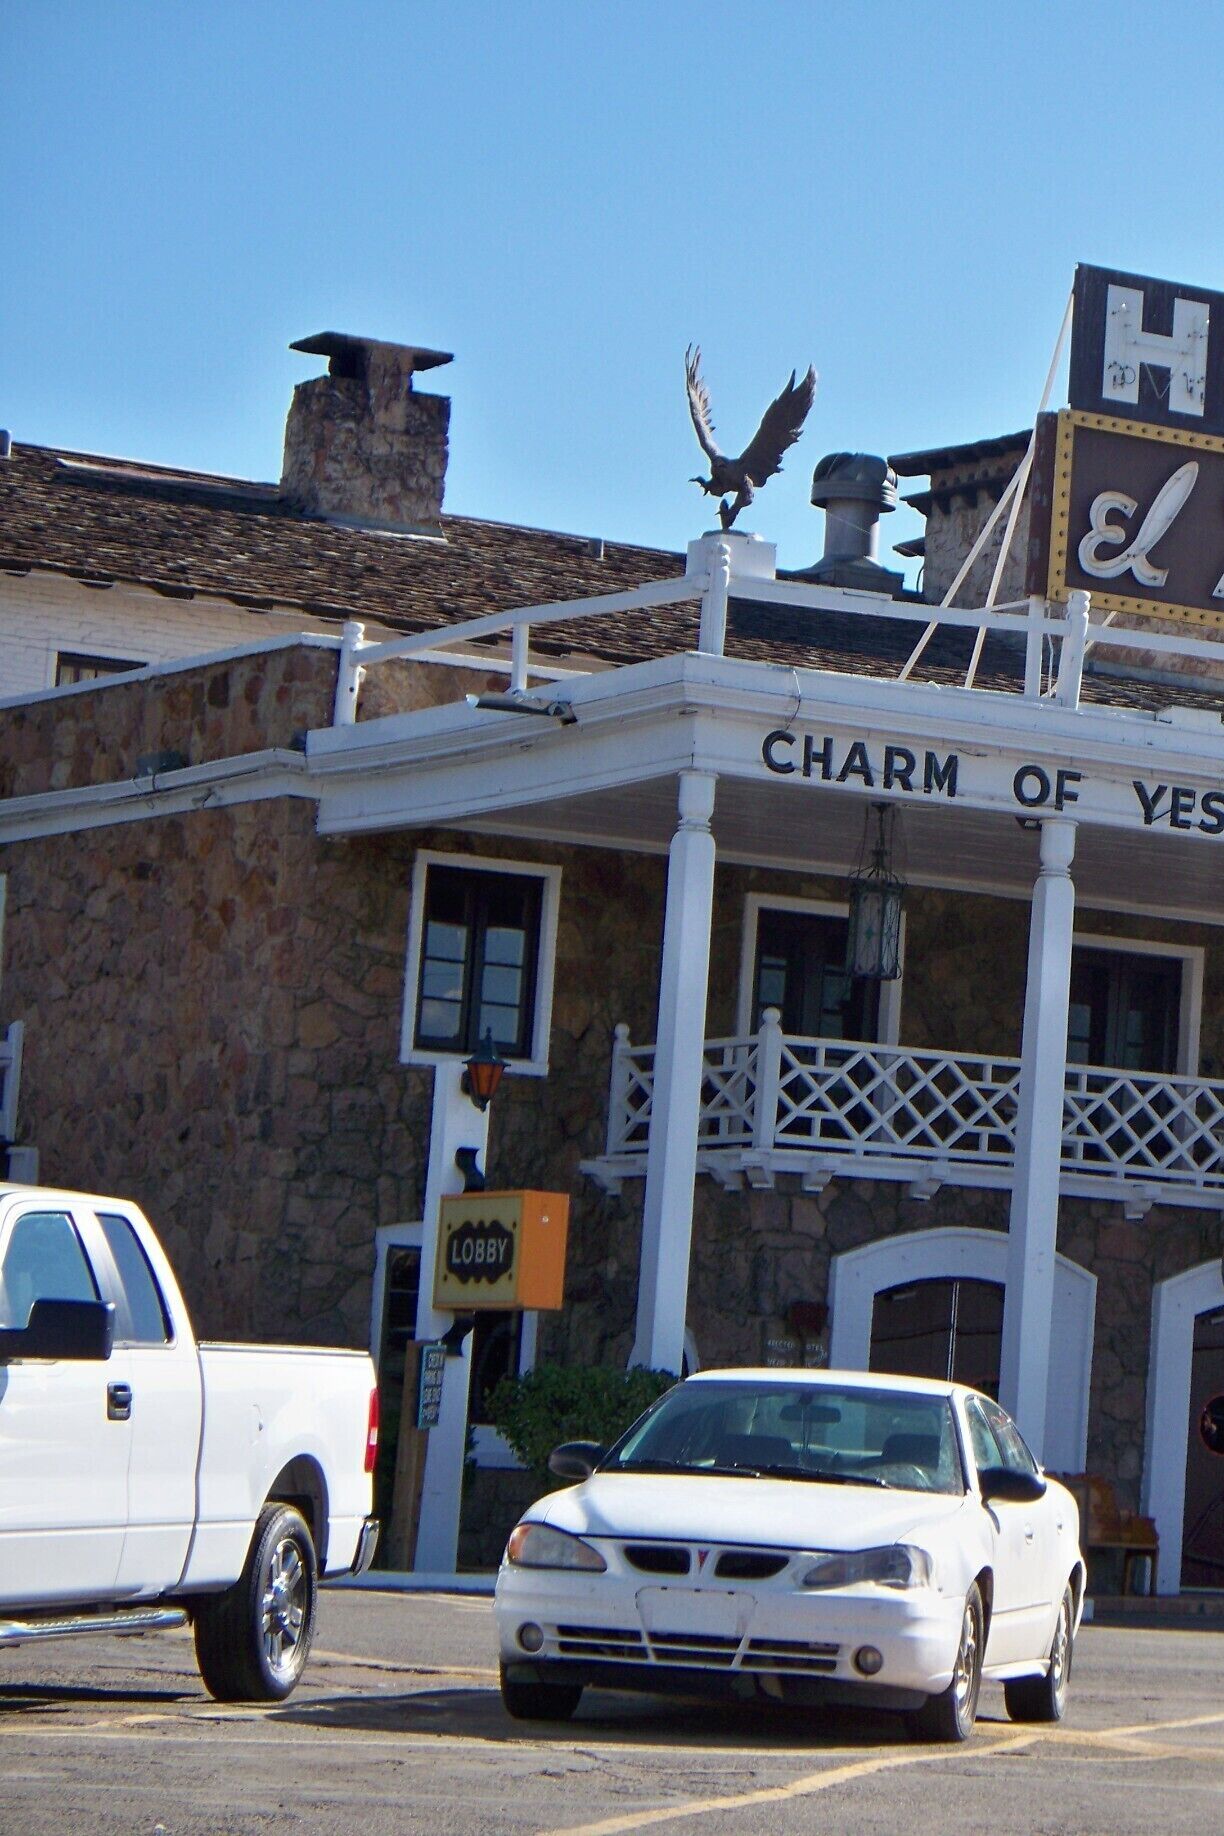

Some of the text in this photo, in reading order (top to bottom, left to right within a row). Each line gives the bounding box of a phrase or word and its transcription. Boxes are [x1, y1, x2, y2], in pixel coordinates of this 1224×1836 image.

[1077, 461, 1198, 588] El
[762, 729, 958, 798] CHARM
[1013, 764, 1082, 811] OF
[451, 1237, 508, 1265] LOBBY
